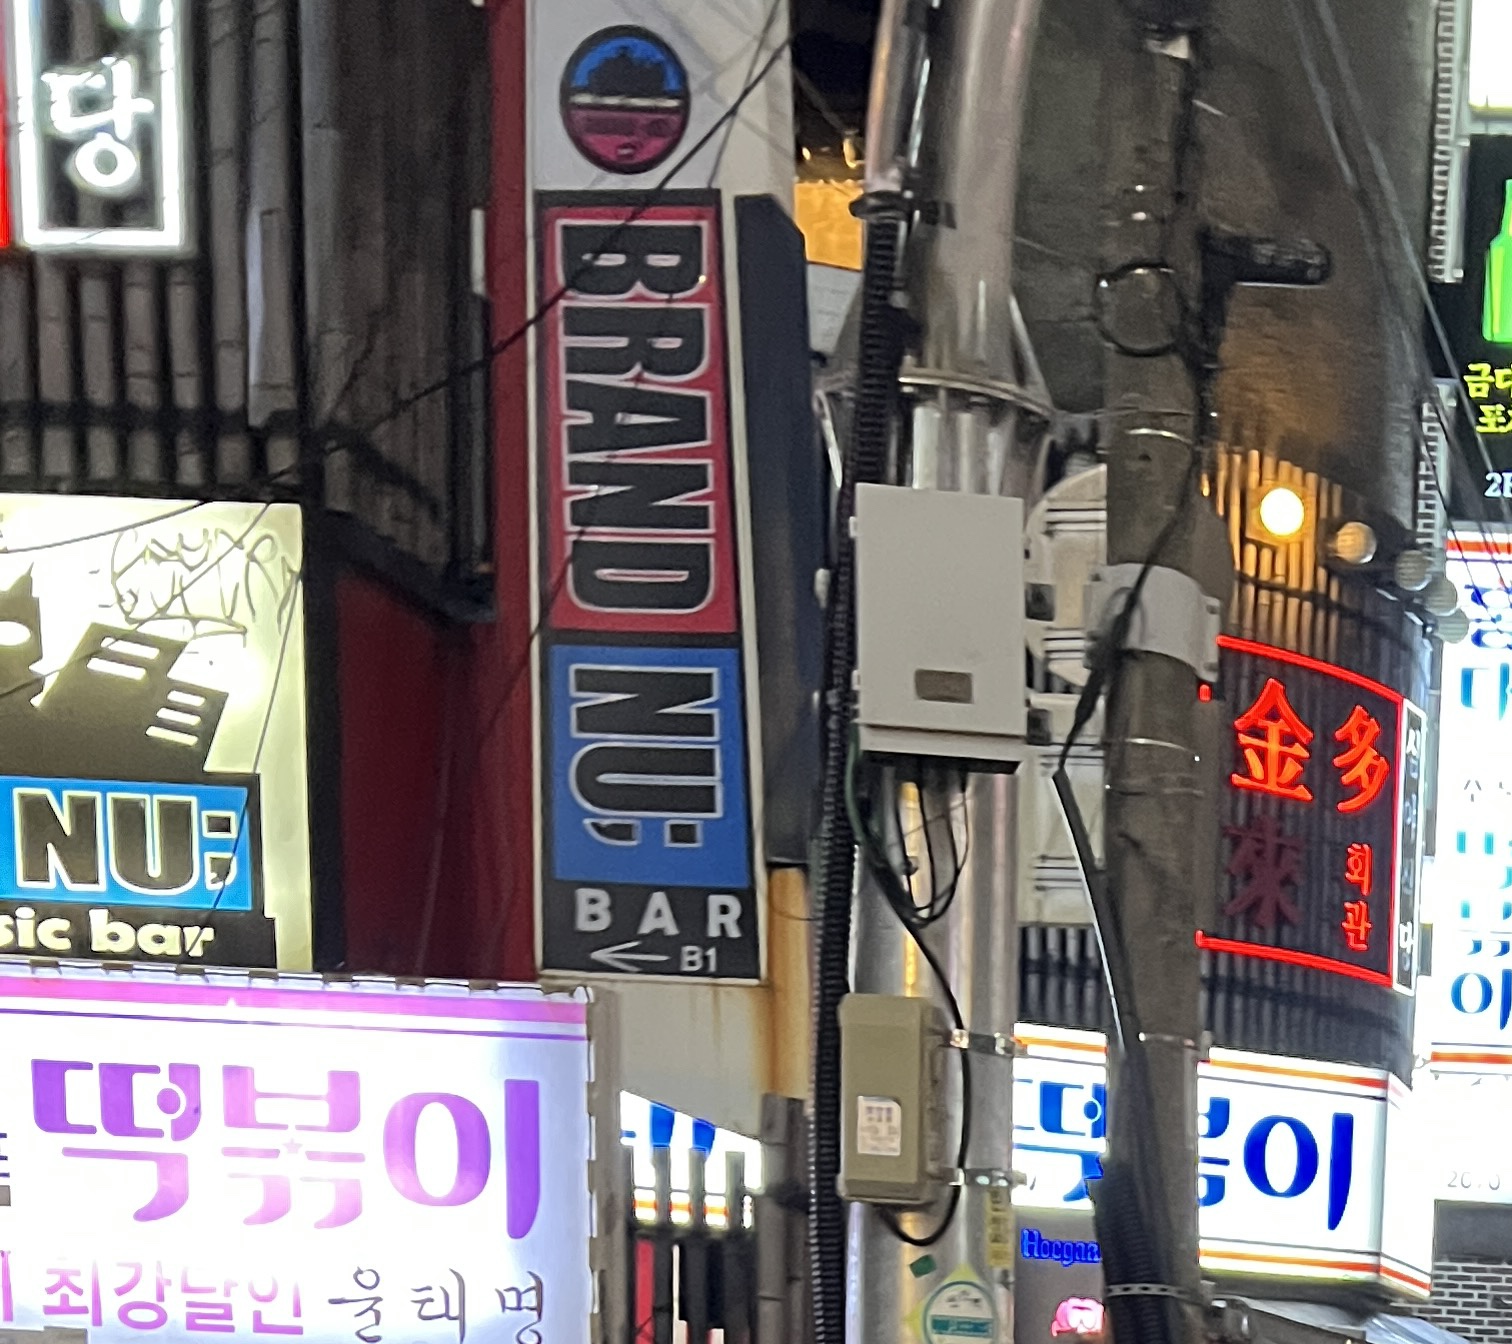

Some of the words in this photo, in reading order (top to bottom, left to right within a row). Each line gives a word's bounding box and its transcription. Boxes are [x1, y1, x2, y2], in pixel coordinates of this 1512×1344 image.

[556, 219, 715, 613] BRAND
[88, 908, 215, 957] bar
[575, 887, 742, 938] BAR
[1342, 843, 1373, 951] 회관
[680, 946, 717, 972] B1
[31, 1058, 541, 1240] 떡볶이
